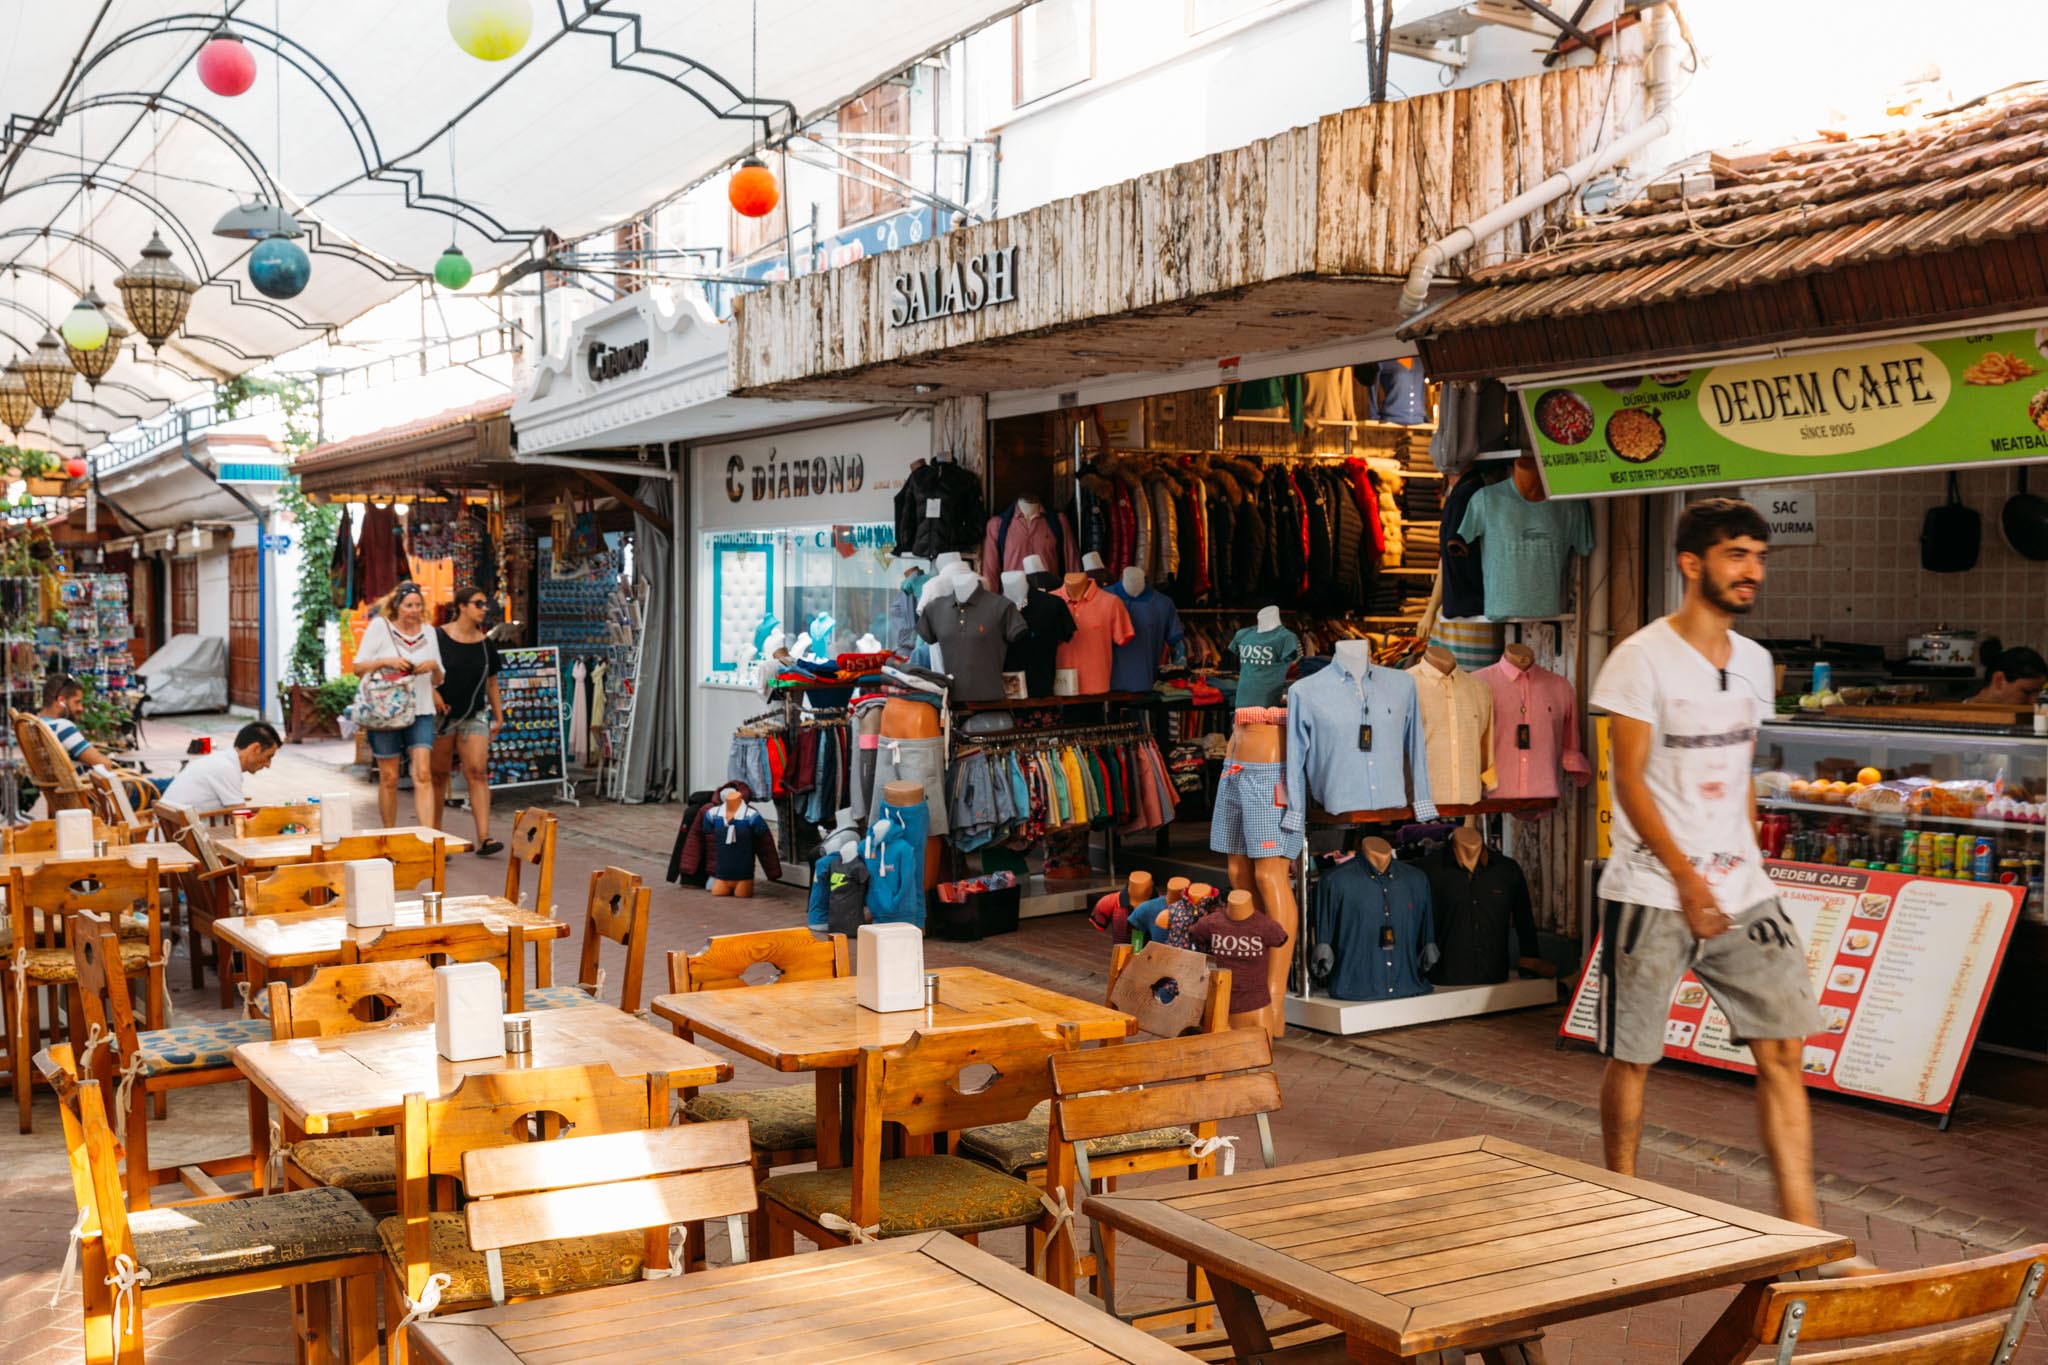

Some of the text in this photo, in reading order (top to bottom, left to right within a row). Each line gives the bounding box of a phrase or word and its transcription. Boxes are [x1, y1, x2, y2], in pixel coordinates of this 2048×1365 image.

[891, 246, 1017, 328] SALASH
[1710, 357, 1937, 426] DEDEM CAFE
[1829, 422, 1856, 438] 2005
[1707, 464, 1721, 477] FRY
[1772, 501, 1798, 514] SAC
[1769, 867, 1859, 888] DEDEM CAFE
[1211, 933, 1263, 951] BOSS
